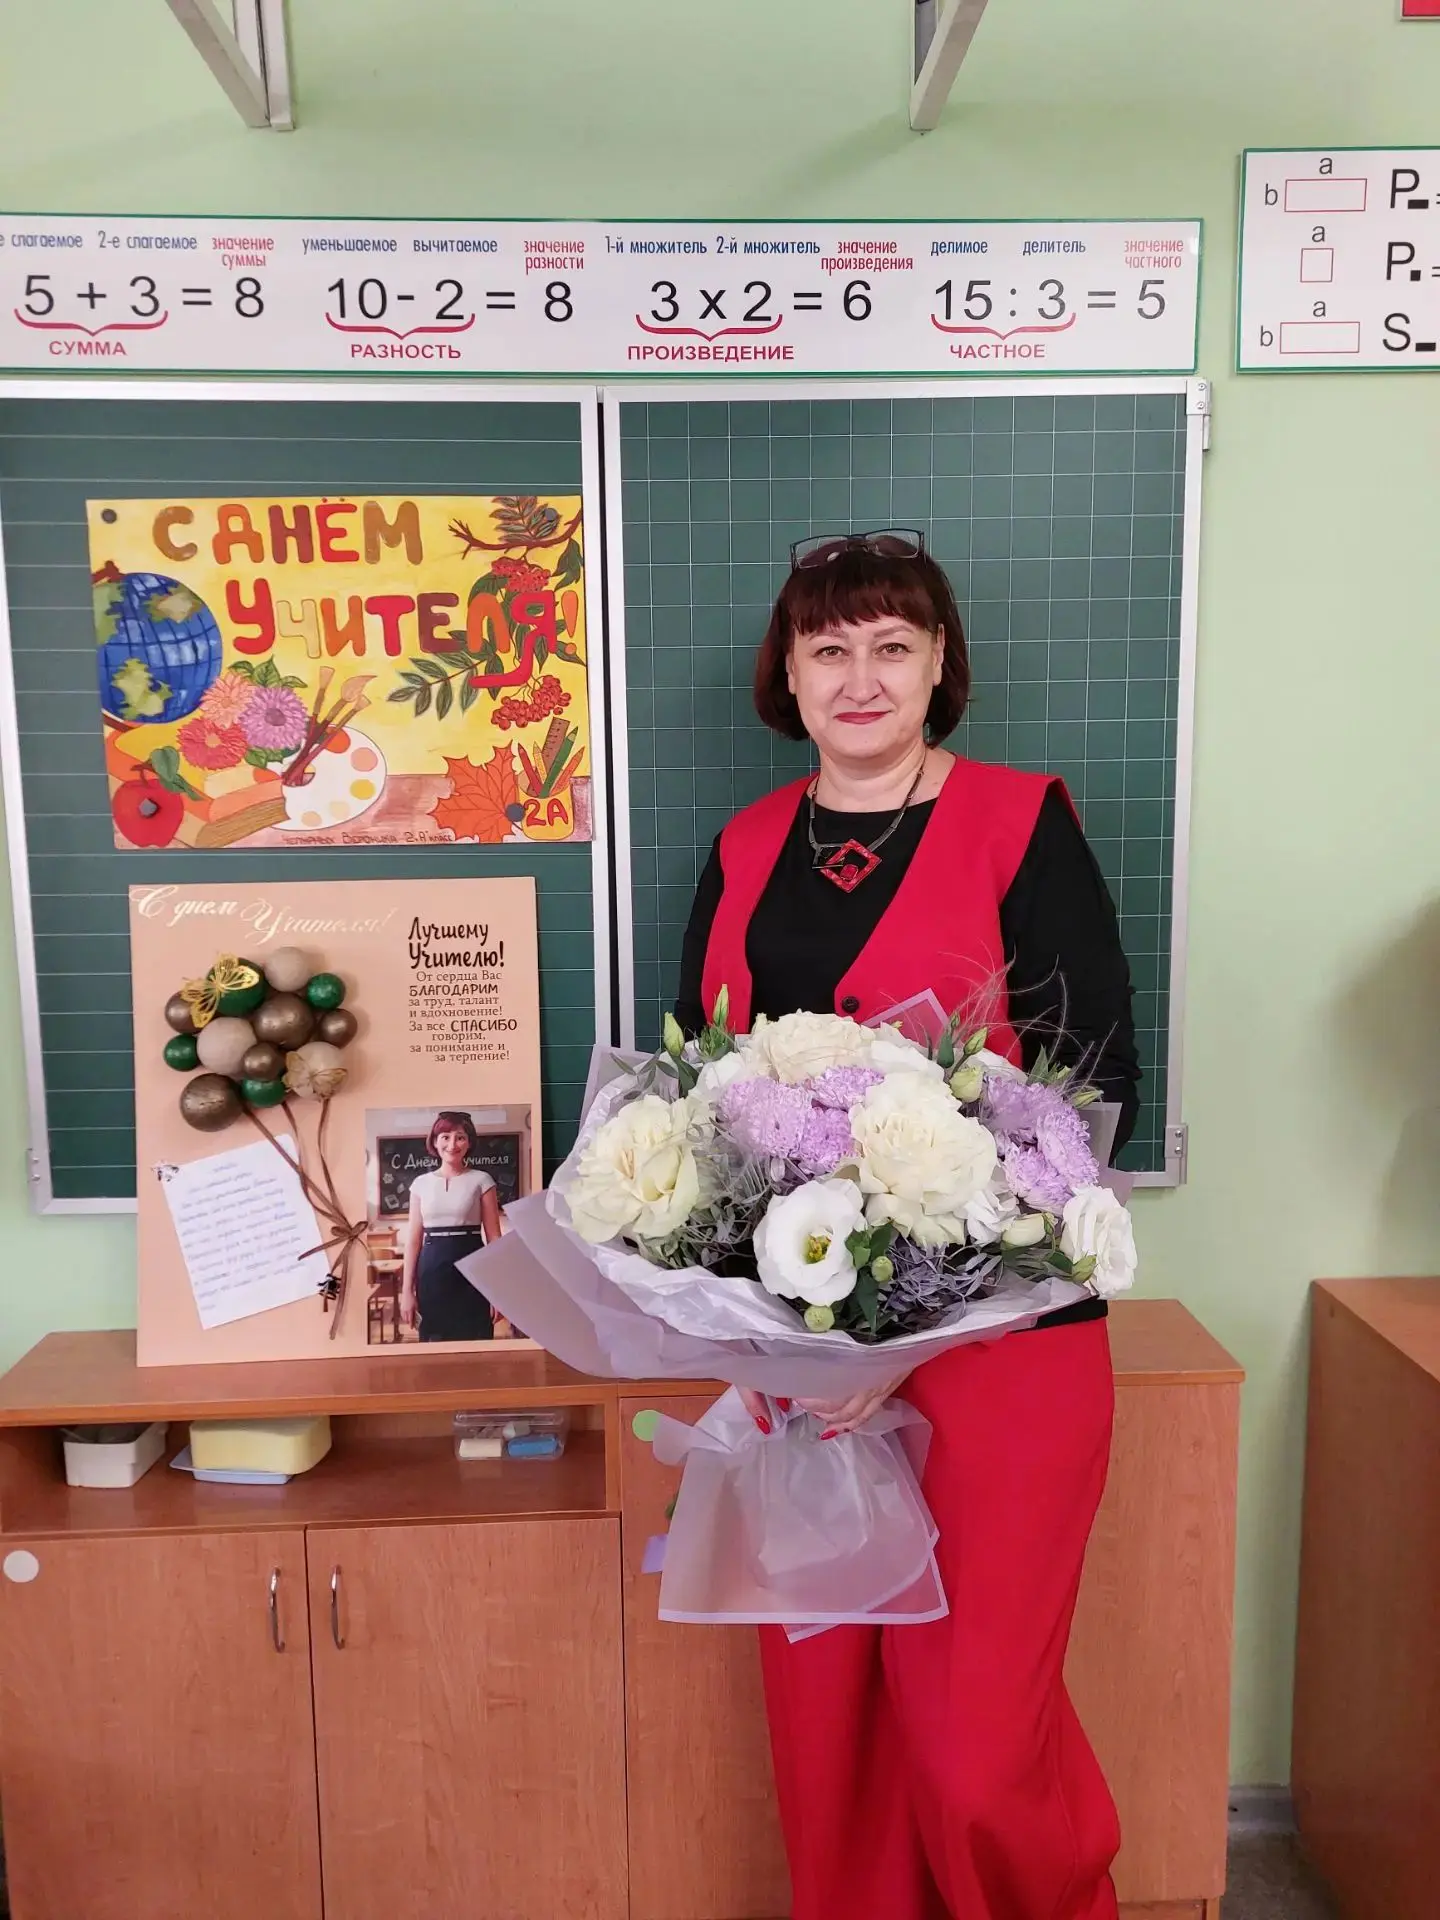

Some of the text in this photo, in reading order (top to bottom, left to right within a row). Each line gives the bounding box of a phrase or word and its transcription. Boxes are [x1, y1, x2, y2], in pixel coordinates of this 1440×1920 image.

[1318, 157, 1333, 175] a
[1264, 183, 1278, 206] b
[11, 233, 83, 249] слагаемое
[97, 230, 197, 250] 2-е слагаемое
[1311, 225, 1326, 243] a
[211, 236, 275, 251] значение
[302, 237, 398, 255] уменьшаемое
[413, 238, 498, 253] вычитаемое
[523, 239, 585, 253] значение
[604, 235, 707, 254] 1-й множитель
[716, 235, 821, 255] 2-й множитель
[837, 240, 897, 254] значение
[931, 240, 988, 256] делимое
[1022, 239, 1086, 256] делитель
[1124, 239, 1184, 253] значение
[221, 253, 266, 270] суммы
[525, 255, 584, 275] разности
[820, 256, 913, 276] произведения
[1124, 254, 1182, 269] частного
[25, 274, 54, 316] 5
[129, 276, 160, 317] 3
[234, 276, 265, 317] 8
[434, 278, 465, 320] 2
[543, 280, 574, 322] 8
[650, 280, 680, 322] 3
[742, 280, 772, 322] 2
[842, 279, 872, 321] 6
[935, 278, 993, 320] 15
[1037, 278, 1067, 320] 3
[1136, 279, 1166, 320] 5
[1312, 300, 1326, 318] a
[1260, 325, 1274, 347] b
[48, 339, 128, 356] СУММА
[350, 343, 462, 360] РАЗНОСТЬ
[627, 345, 795, 363] ПРОИЗВЕДЕНИЕ
[949, 343, 1046, 359] ЧАСТНОЕ
[151, 496, 425, 566] С ДНЁМ
[224, 577, 580, 690] УЧИТЕЛЯ!
[522, 797, 570, 829] 2А
[128, 885, 398, 947] С днем Учителя!
[408, 916, 489, 947] Лучшему
[408, 940, 505, 970] Учителю!
[416, 969, 502, 985] От сердца Вас
[409, 983, 498, 997] БЛАГОДАРИМ
[408, 998, 420, 1007] за
[458, 996, 500, 1006] талант
[409, 1005, 503, 1018] и вдохновение!
[408, 1018, 518, 1033] За все СПАСИБО
[409, 1042, 506, 1053] за понимание и
[434, 1050, 510, 1065] за терпение!
[390, 1153, 402, 1170] С
[462, 1153, 510, 1168] учителя
